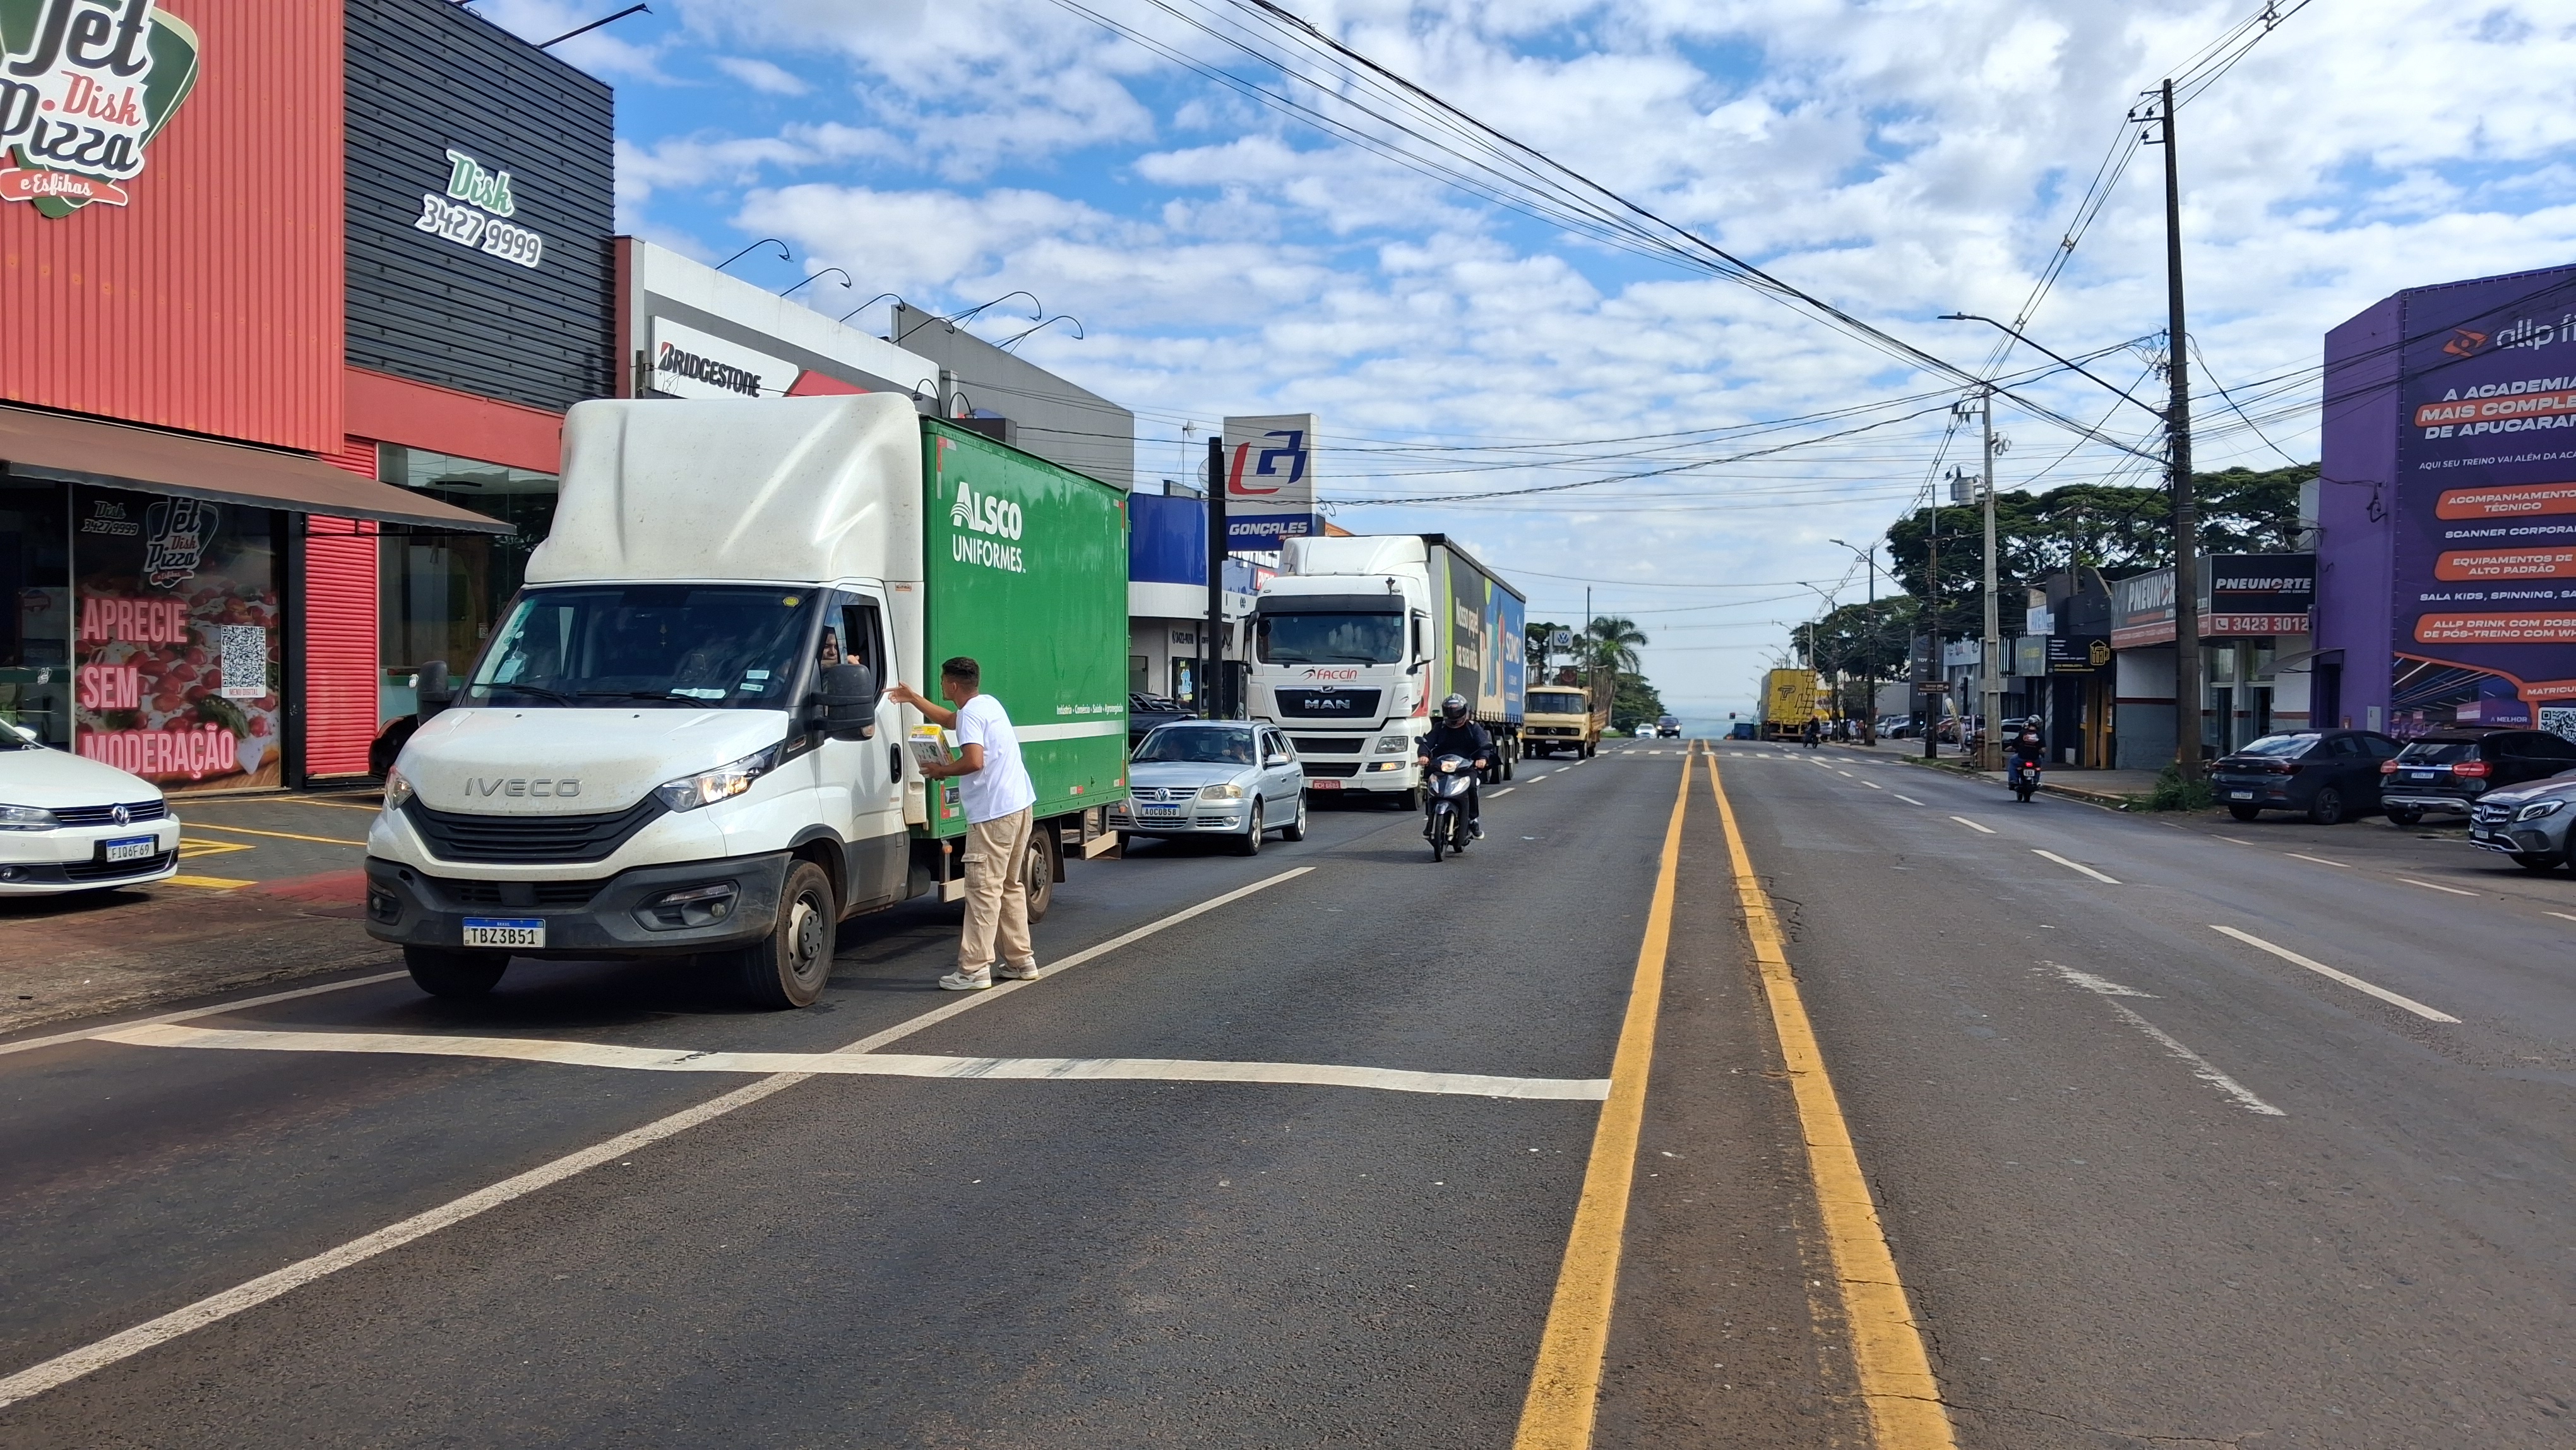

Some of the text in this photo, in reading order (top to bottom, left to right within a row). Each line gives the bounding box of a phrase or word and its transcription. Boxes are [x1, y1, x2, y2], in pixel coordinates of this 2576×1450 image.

[61, 70, 141, 126] Disk
[0, 78, 138, 171] Pizza
[33, 173, 93, 196] Esfihas
[447, 150, 514, 215] Disk
[420, 198, 539, 263] 3427 9999
[658, 341, 761, 398] BRIDGESTONE
[2442, 388, 2458, 402] A
[2421, 395, 2576, 422] MAIS COMPLE
[2424, 424, 2455, 440] DE
[2419, 462, 2441, 470] AQUI
[2443, 459, 2460, 468] SEU
[2462, 457, 2495, 467] TREINO
[2515, 452, 2541, 462] ALÉM
[2448, 490, 2576, 504] ACOMPANHAMENTO
[95, 501, 126, 518] Disk
[950, 481, 1022, 541] ALSCO
[2484, 502, 2541, 512] TÉCNICO
[154, 496, 200, 542] Jet
[112, 522, 138, 536] 9999
[1229, 522, 1308, 536] GONÇALES
[2445, 525, 2576, 539] SCANNER CORPORA
[170, 536, 198, 550] Disk
[147, 543, 198, 569] Pizza
[2453, 554, 2573, 567] EQUIPAMENTOS DE
[2469, 563, 2555, 575] ALTO PADRÃO
[2128, 571, 2176, 612] PNEUNOR
[2215, 578, 2312, 589] PNEUNORTE
[2454, 592, 2488, 601] KIDS,
[2490, 590, 2558, 599] SPINNING,
[83, 599, 188, 643] APRECIE
[1456, 597, 1469, 630] Nosso
[2233, 617, 2269, 631] 3423
[2423, 630, 2440, 638] DE
[2442, 629, 2520, 638] PÓS-TREINO
[84, 666, 138, 709] SEM
[2527, 686, 2576, 695] MATRICU
[1304, 700, 1351, 709] MAN
[85, 724, 234, 779] MODERAÇÃO
[465, 778, 583, 796] IVECO
[470, 928, 535, 944] TBZ3B51
